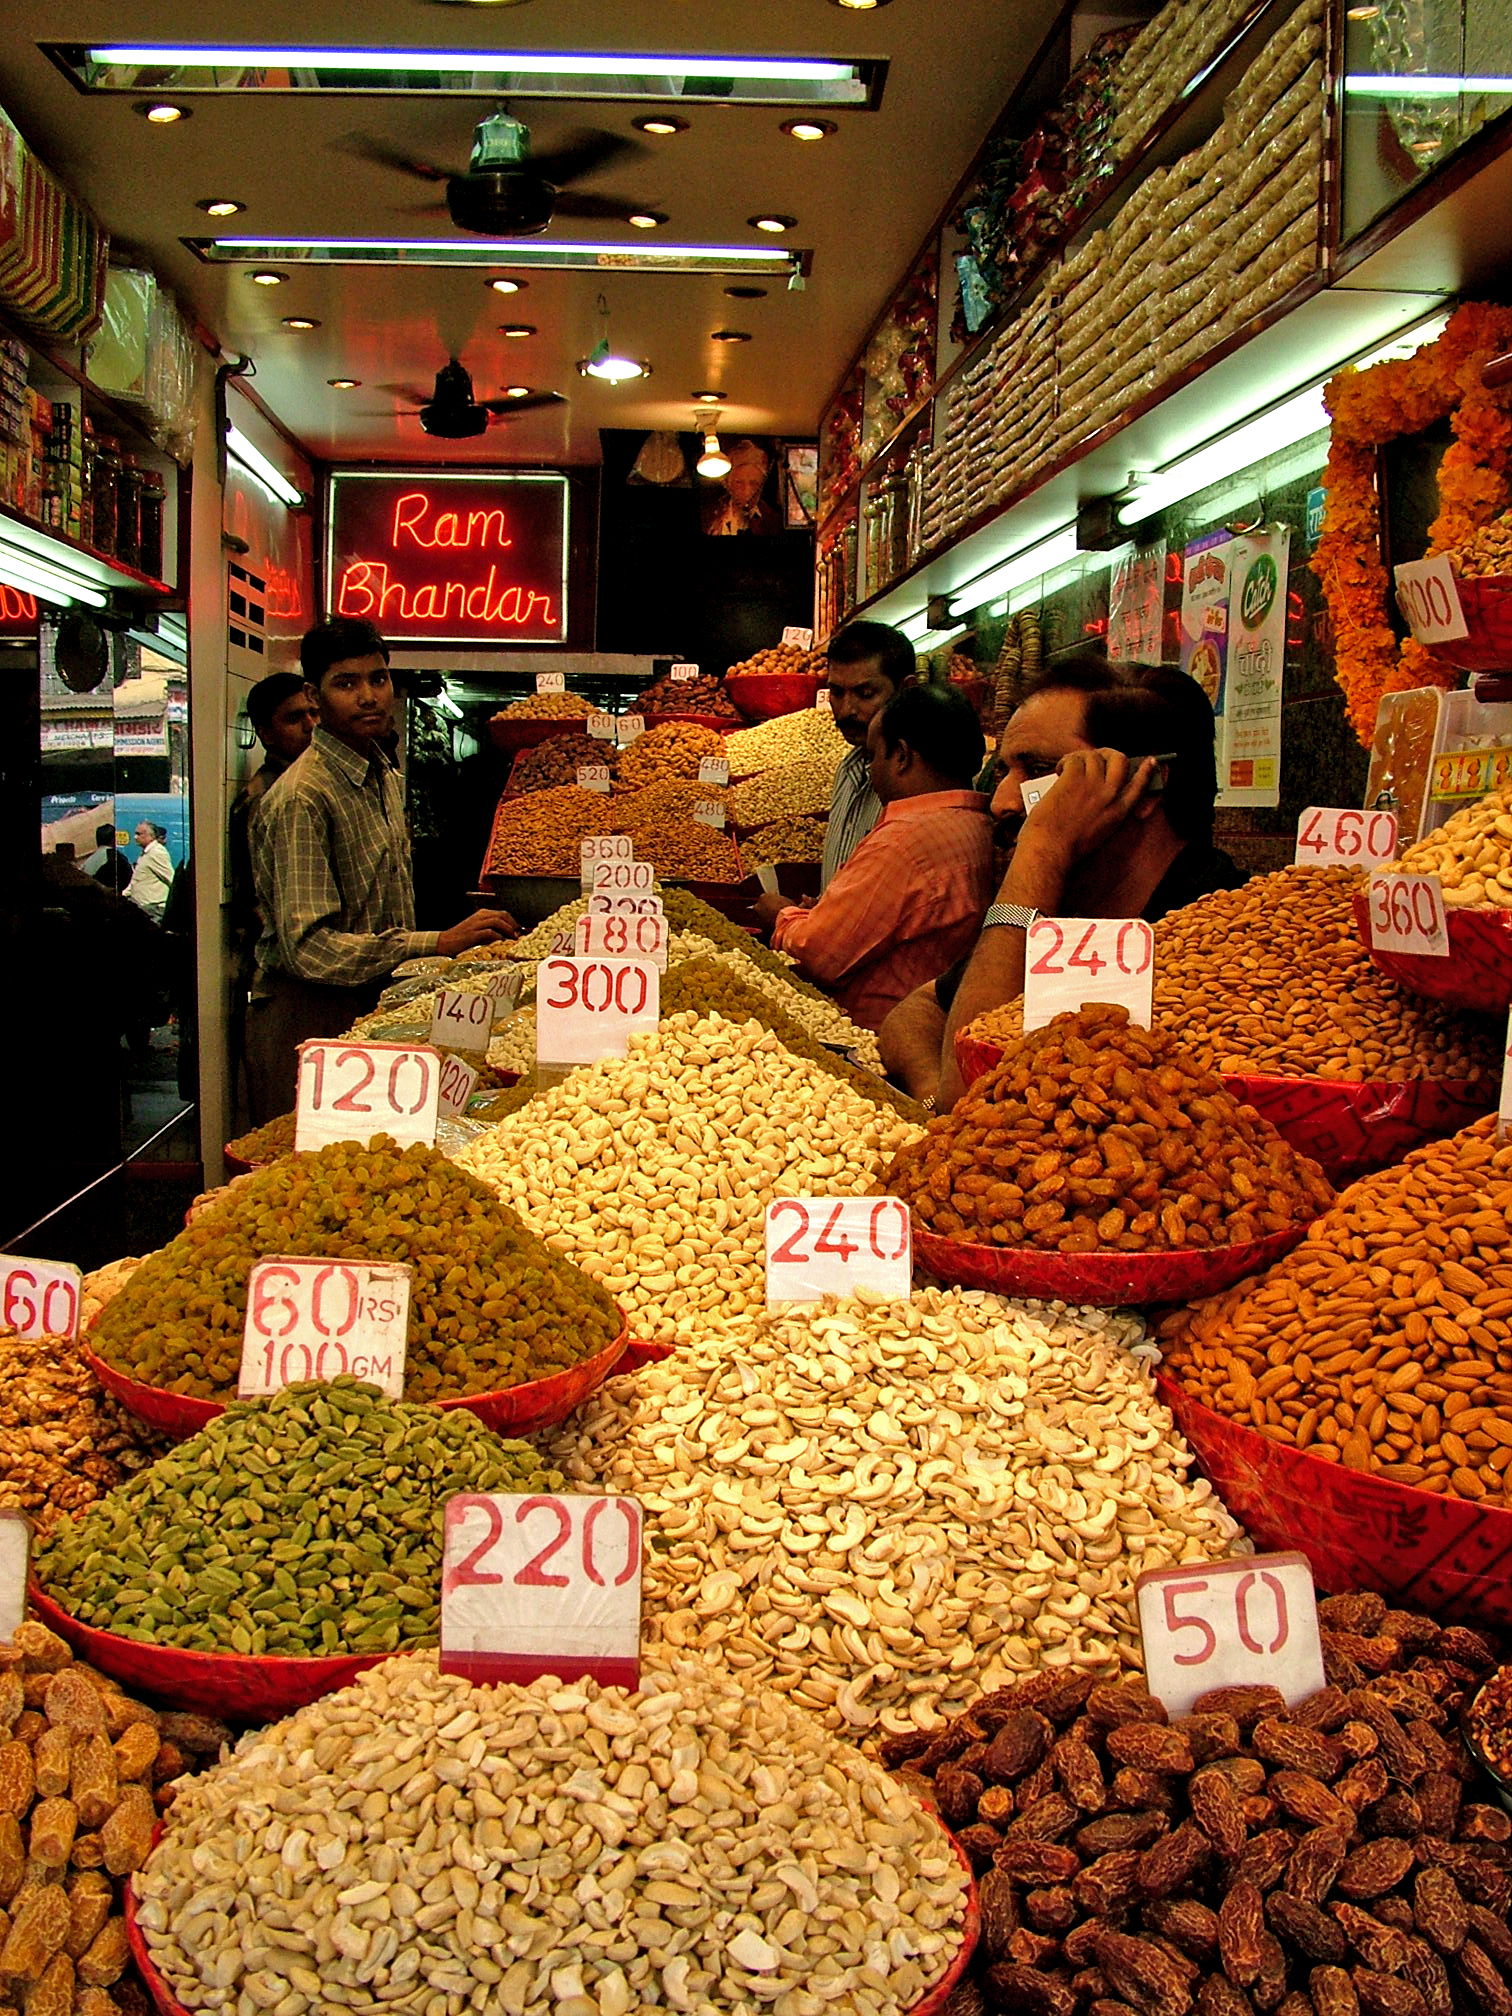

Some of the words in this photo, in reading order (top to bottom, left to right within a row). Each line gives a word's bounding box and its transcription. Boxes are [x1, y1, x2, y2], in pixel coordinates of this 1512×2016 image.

[393, 493, 512, 549] Ram
[338, 561, 557, 625] Bhandar
[538, 673, 564, 688] 240
[673, 665, 697, 679] 100
[591, 715, 611, 728] 60
[619, 717, 642, 731] 60
[578, 766, 609, 782] 520
[701, 759, 729, 773] 480
[695, 802, 724, 817] 480
[581, 838, 630, 859] 360
[1299, 810, 1396, 858] 460
[596, 865, 650, 889] 200
[1373, 881, 1438, 936] 360
[579, 916, 661, 954] 180
[1030, 921, 1153, 976] 240
[436, 991, 487, 1024] 140
[547, 960, 648, 1014] 300
[304, 1049, 430, 1115] 120
[439, 1064, 470, 1107] 120
[769, 1200, 909, 1263] 240
[4, 1270, 76, 1337] 60
[253, 1266, 359, 1337] 60
[358, 1296, 396, 1323] RS
[264, 1340, 348, 1386] 100
[351, 1355, 392, 1379] GM
[450, 1495, 641, 1587] 220
[1162, 1571, 1288, 1666] 50
